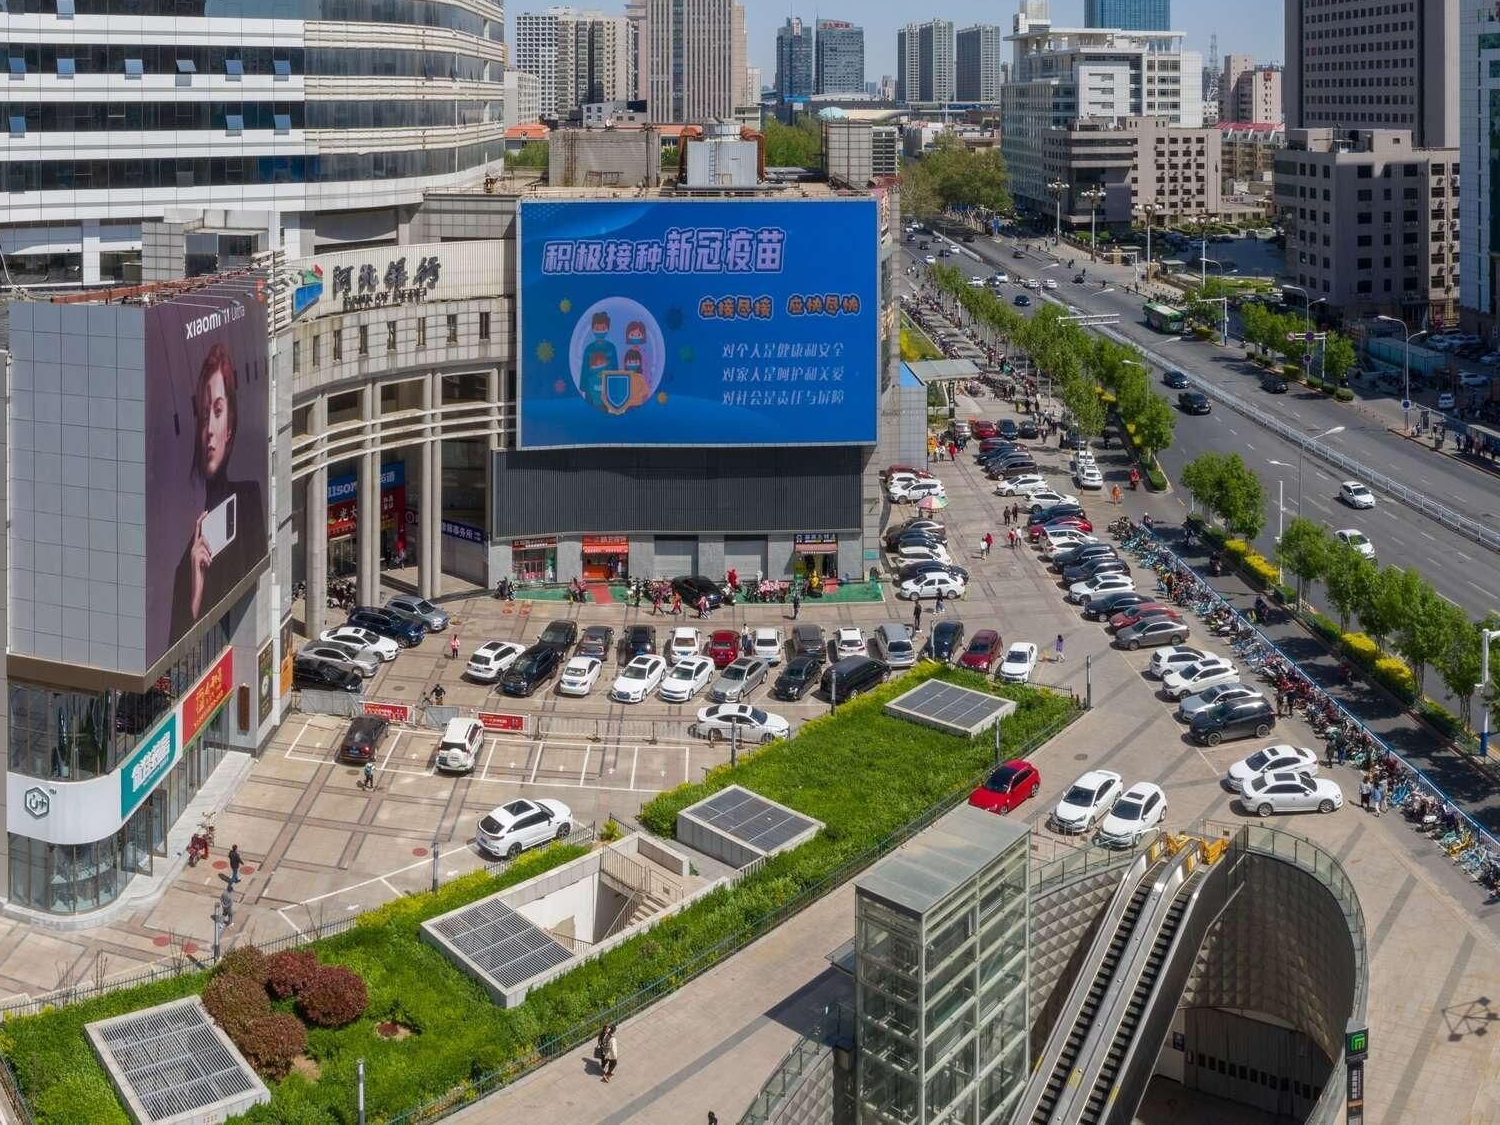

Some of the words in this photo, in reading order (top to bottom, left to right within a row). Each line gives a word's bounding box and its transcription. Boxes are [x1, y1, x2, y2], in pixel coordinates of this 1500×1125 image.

[543, 228, 785, 274] 积极接种新冠疫苗
[722, 342, 845, 359] 对个人是健康和安全
